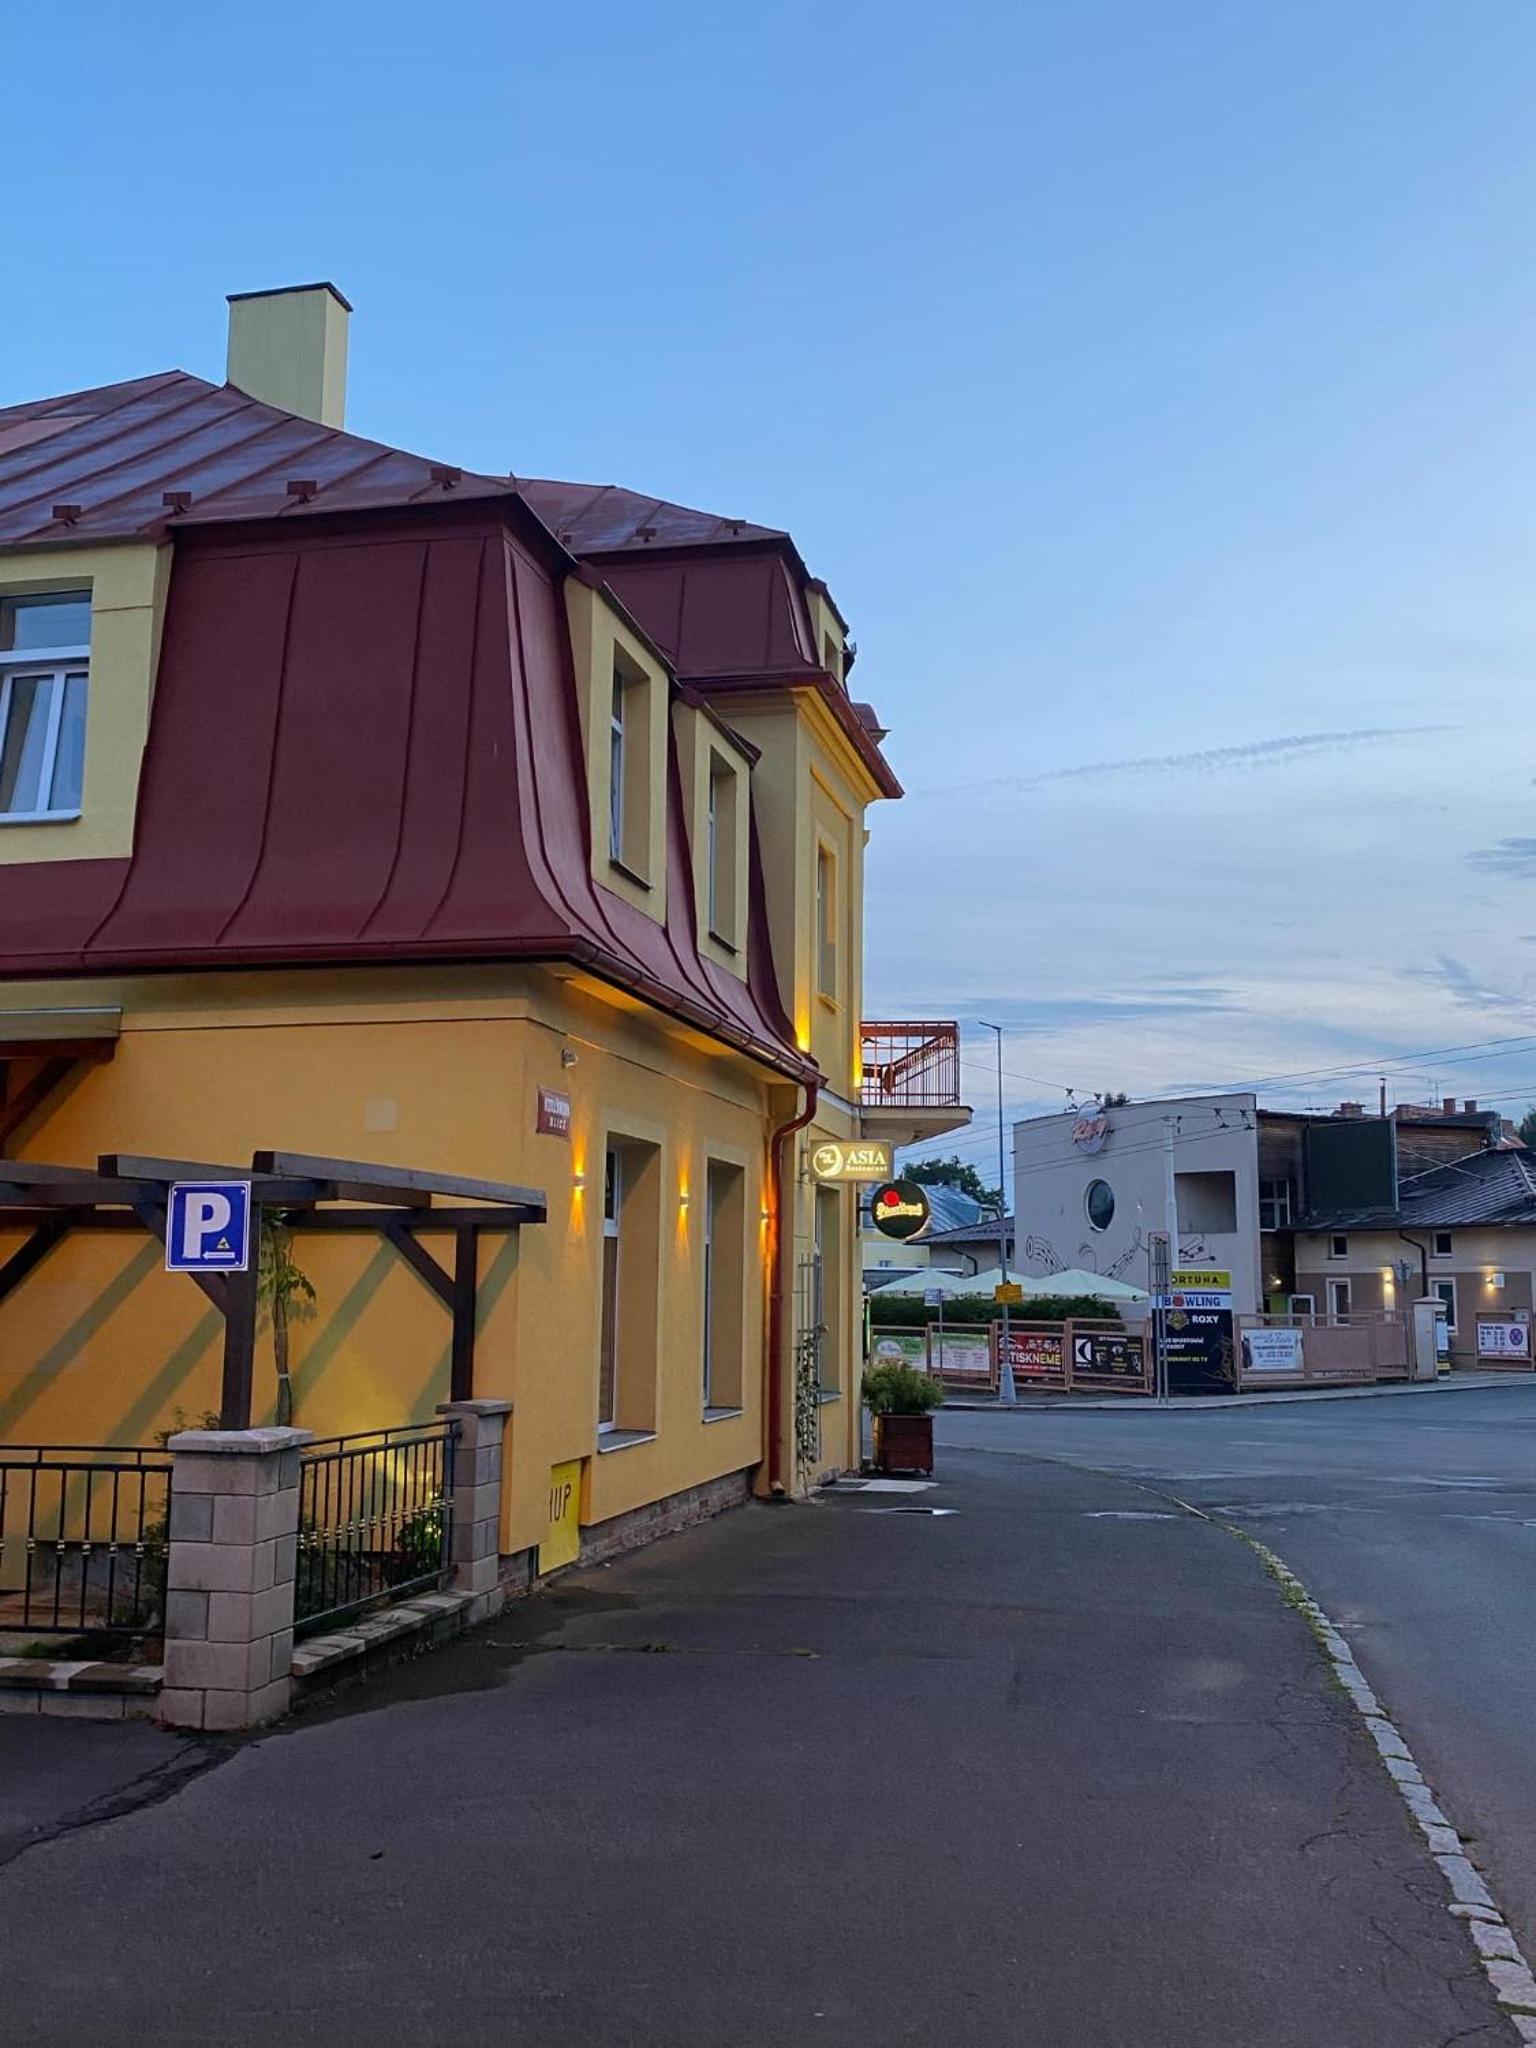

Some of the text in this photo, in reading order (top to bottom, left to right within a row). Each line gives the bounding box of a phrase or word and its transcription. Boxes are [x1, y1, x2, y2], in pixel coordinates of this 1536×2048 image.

[847, 1150, 886, 1164] ASIA
[183, 1192, 231, 1259] P
[1172, 1275, 1219, 1285] ORTUNA
[1164, 1296, 1221, 1307] BOWLING
[1191, 1315, 1219, 1324] ROXY
[1010, 1351, 1062, 1365] TISKNEME
